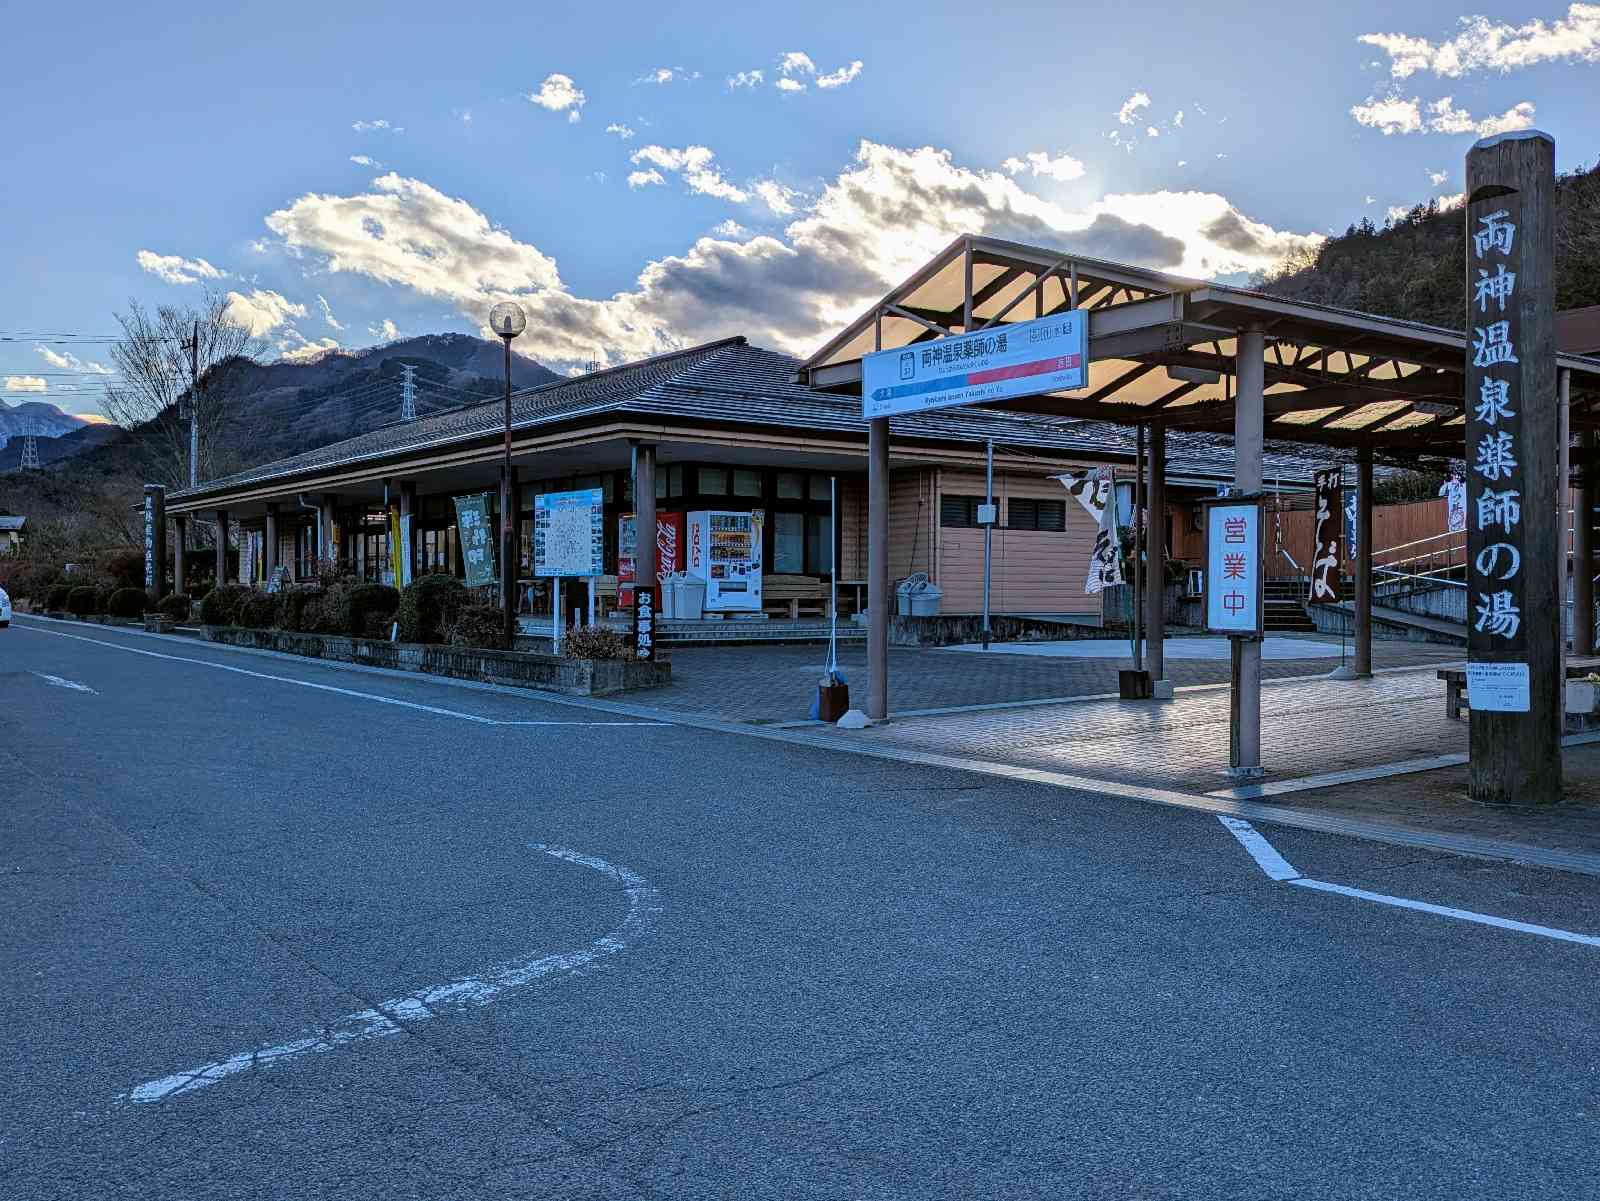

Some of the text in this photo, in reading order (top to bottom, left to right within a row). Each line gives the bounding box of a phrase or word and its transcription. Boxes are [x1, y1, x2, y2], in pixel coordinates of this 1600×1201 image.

[921, 332, 1008, 369] 両神温泉薬師の湯
[1473, 207, 1521, 640] 両神温泉薬師の湯
[1223, 516, 1247, 617] 営業中
